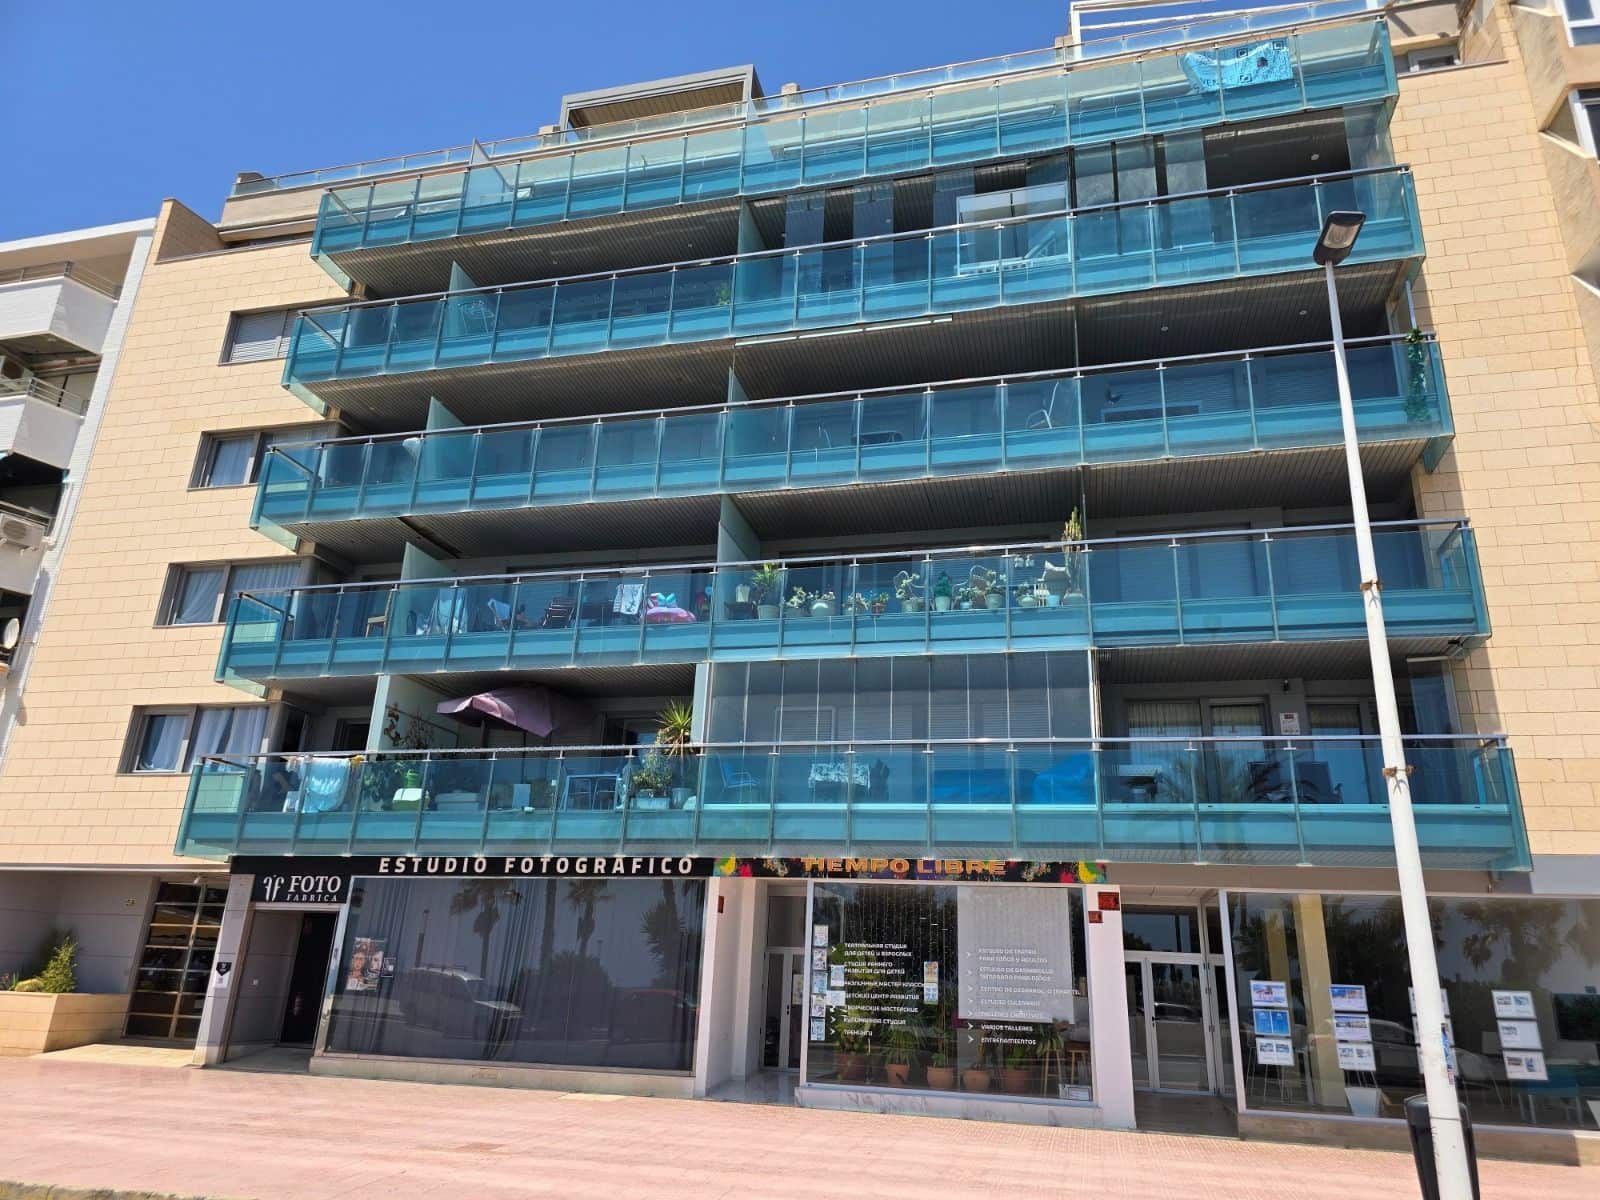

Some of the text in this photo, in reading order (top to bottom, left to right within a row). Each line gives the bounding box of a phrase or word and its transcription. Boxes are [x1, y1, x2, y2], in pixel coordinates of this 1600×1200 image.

[379, 857, 488, 873] ESTUDIO
[801, 857, 1007, 875] TIEMPO LIBRE
[288, 875, 342, 893] FOTO
[286, 893, 338, 902] FABRICA
